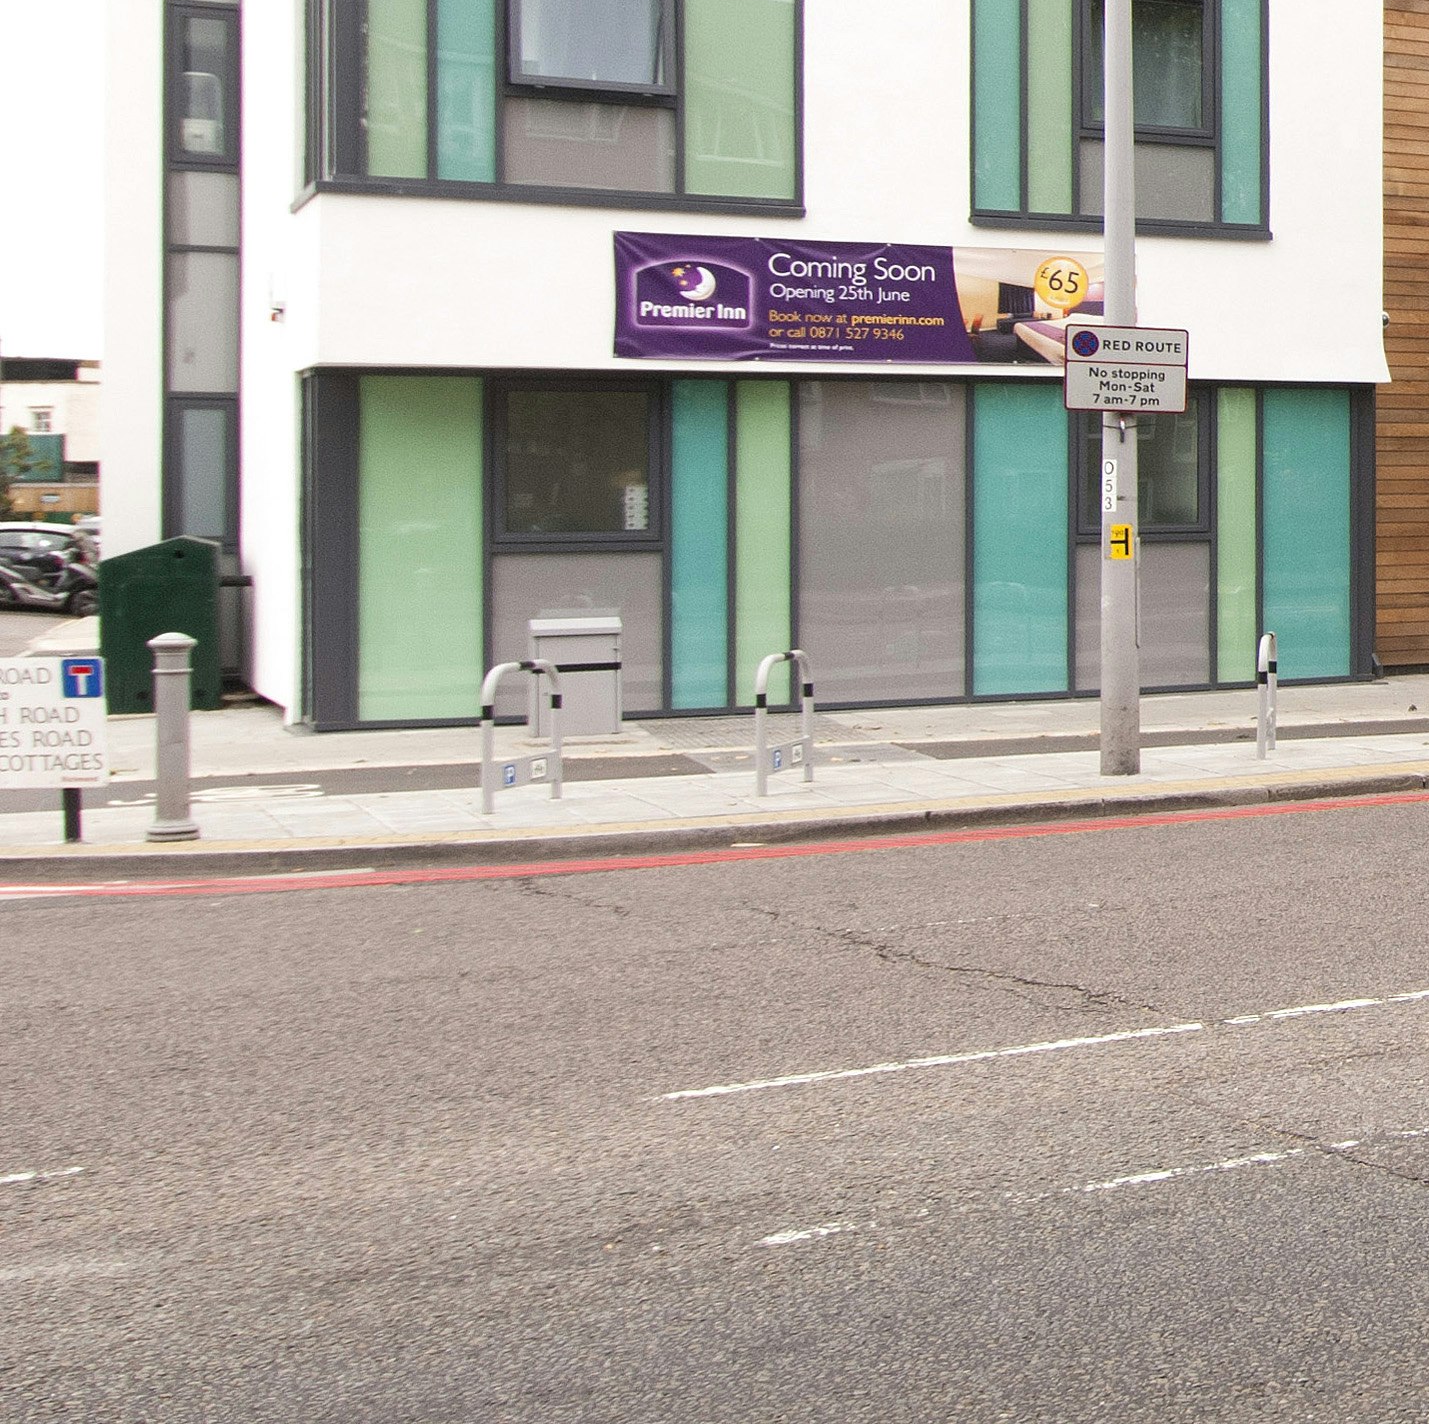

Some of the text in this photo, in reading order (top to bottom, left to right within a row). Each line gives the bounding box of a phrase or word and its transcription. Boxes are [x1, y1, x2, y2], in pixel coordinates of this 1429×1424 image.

[768, 252, 936, 285] Coming Soon
[1040, 267, 1080, 294] £65
[769, 283, 911, 304] Opening 25th June
[640, 300, 747, 320] Premier Inn
[768, 309, 945, 327] Book now at premierinn.com
[768, 326, 905, 341] or call 0871 527 9346
[1102, 339, 1182, 354] RED ROUTE
[1088, 367, 1166, 382] No stopping
[1099, 381, 1156, 393] Mon-Sat
[1140, 397, 1160, 407] pm
[20, 706, 80, 724] ROAD
[32, 729, 92, 748] ROAD
[0, 753, 103, 772] COTTAGES
